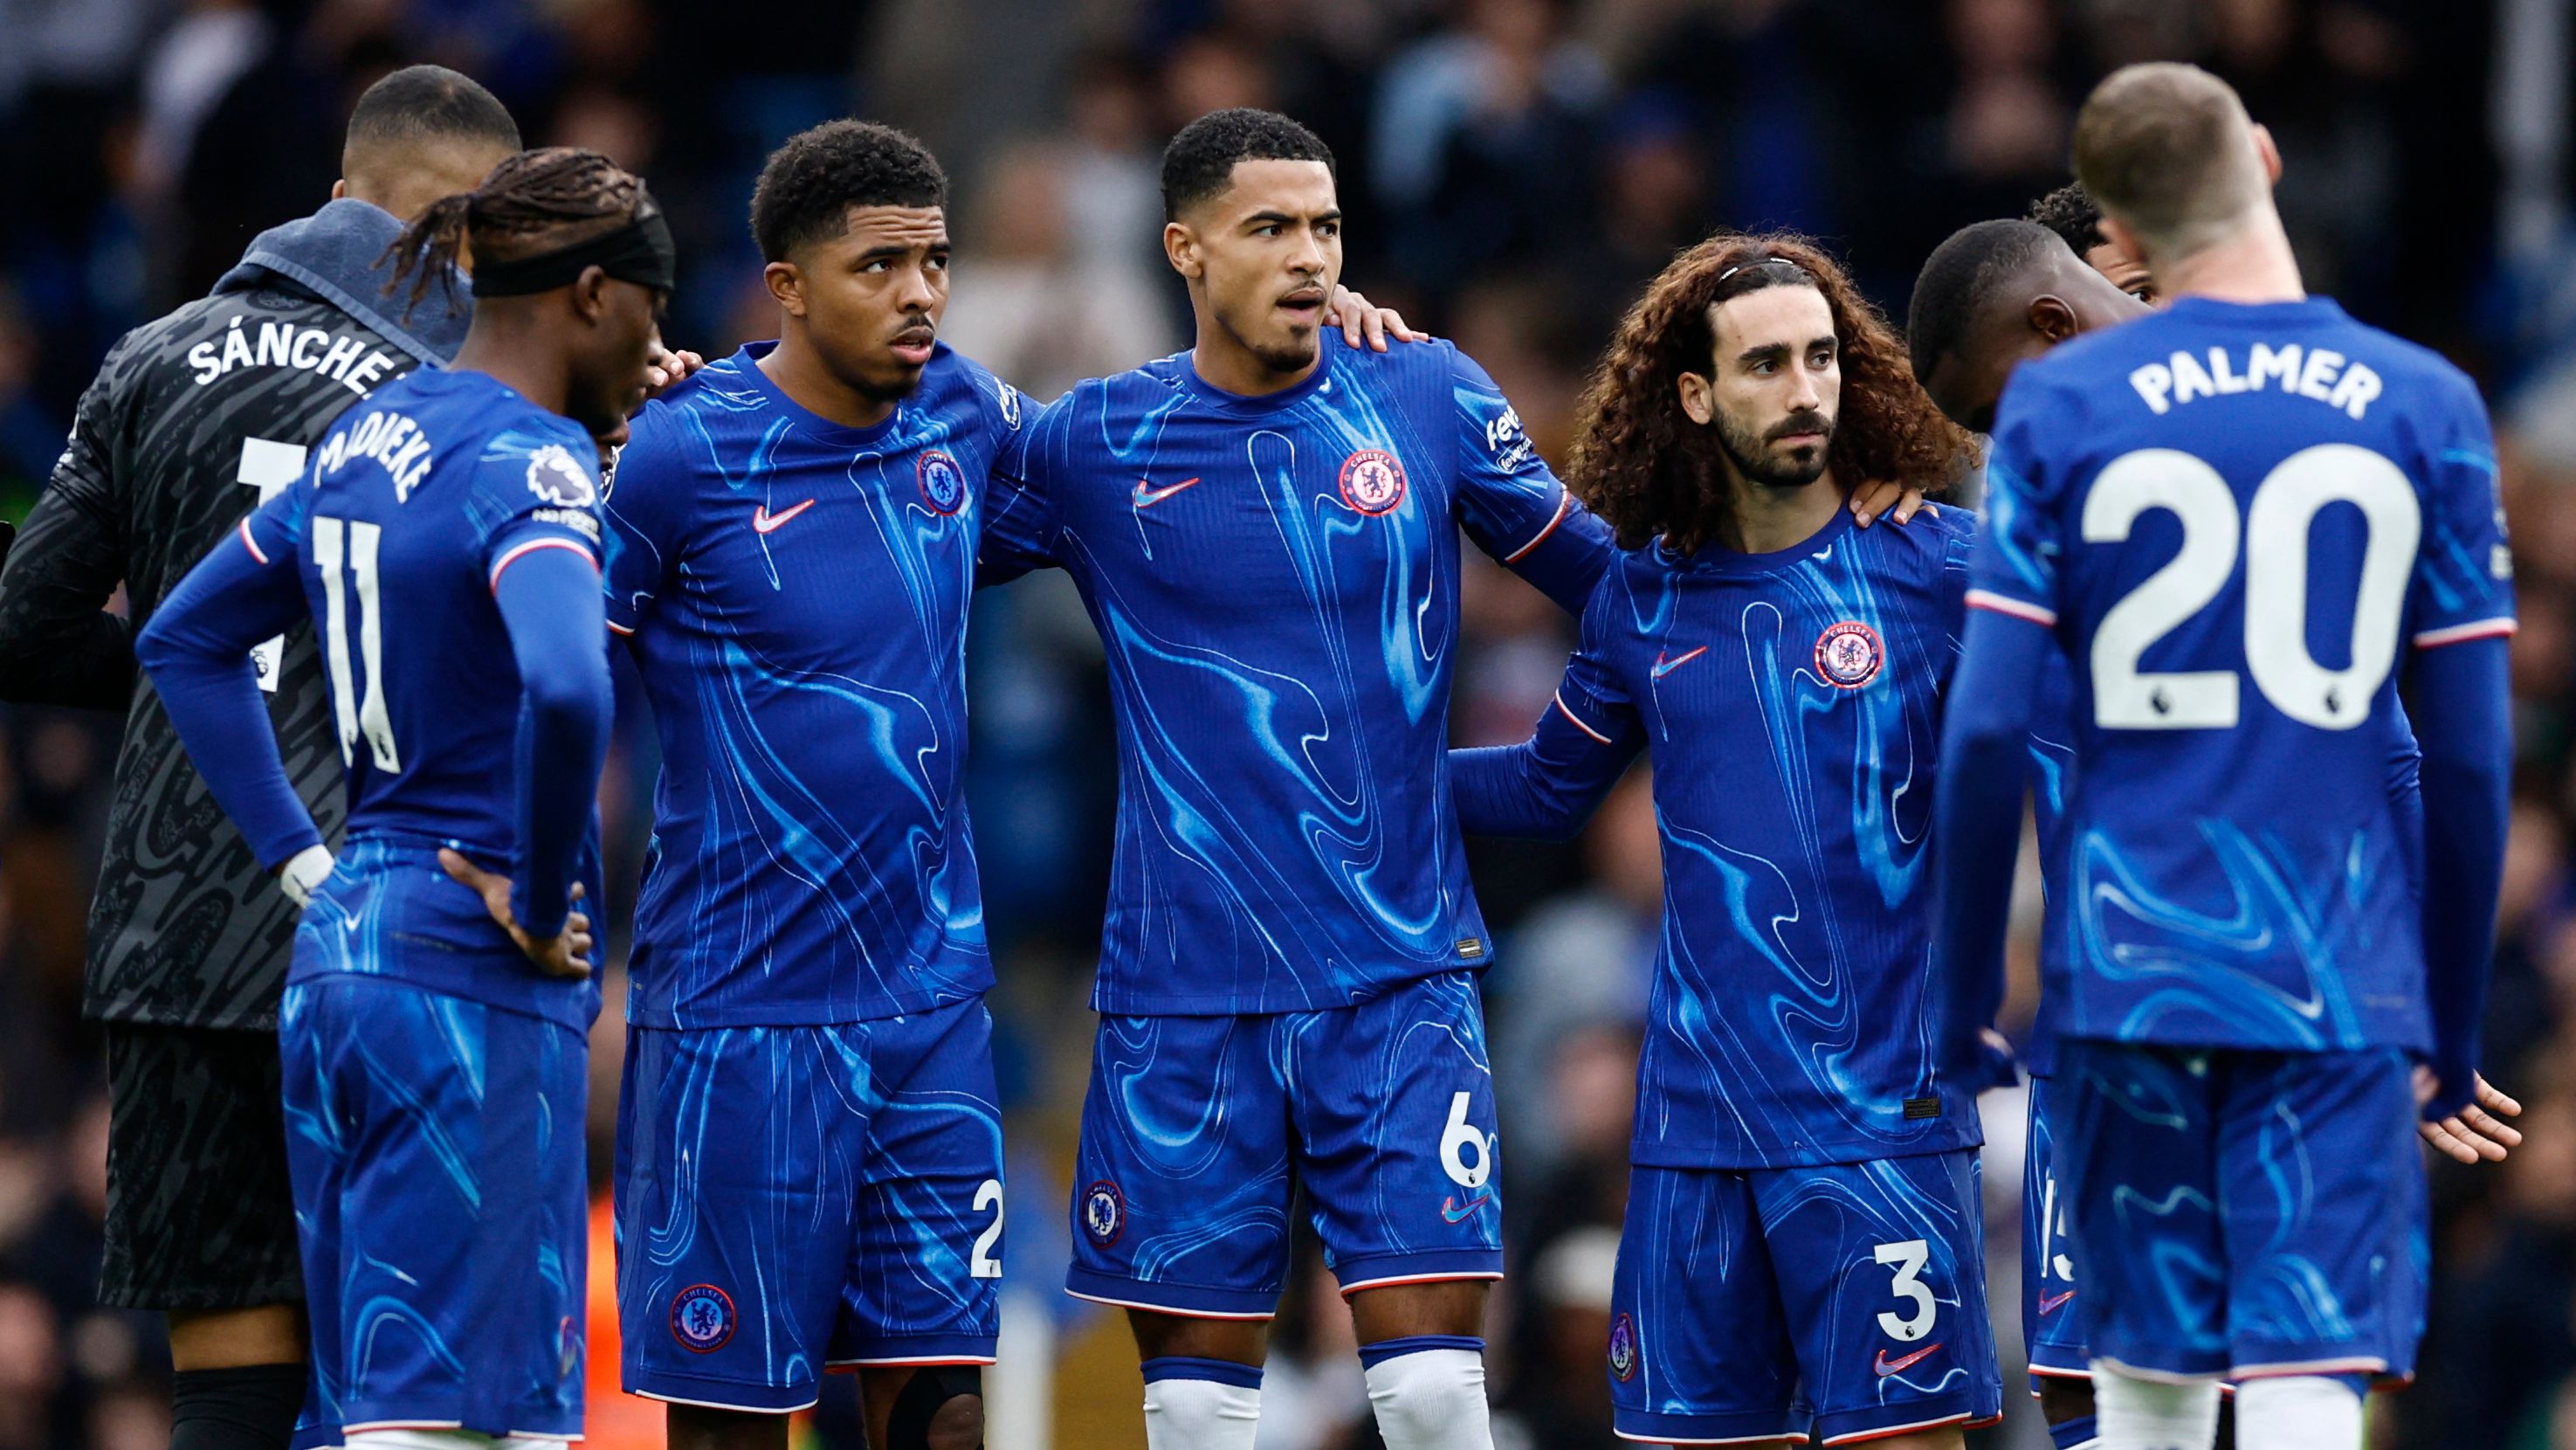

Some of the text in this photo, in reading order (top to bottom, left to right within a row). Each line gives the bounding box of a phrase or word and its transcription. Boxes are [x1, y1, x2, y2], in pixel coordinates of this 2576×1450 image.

[187, 315, 406, 400] SÁNCHE
[2129, 342, 2383, 421] PALMER
[1350, 452, 1391, 467] CHELSEA
[2081, 442, 2422, 731] 20
[313, 515, 402, 775] 11
[1439, 1091, 1491, 1188] 6
[970, 1178, 1004, 1278] 2
[1874, 1239, 1937, 1342] 3
